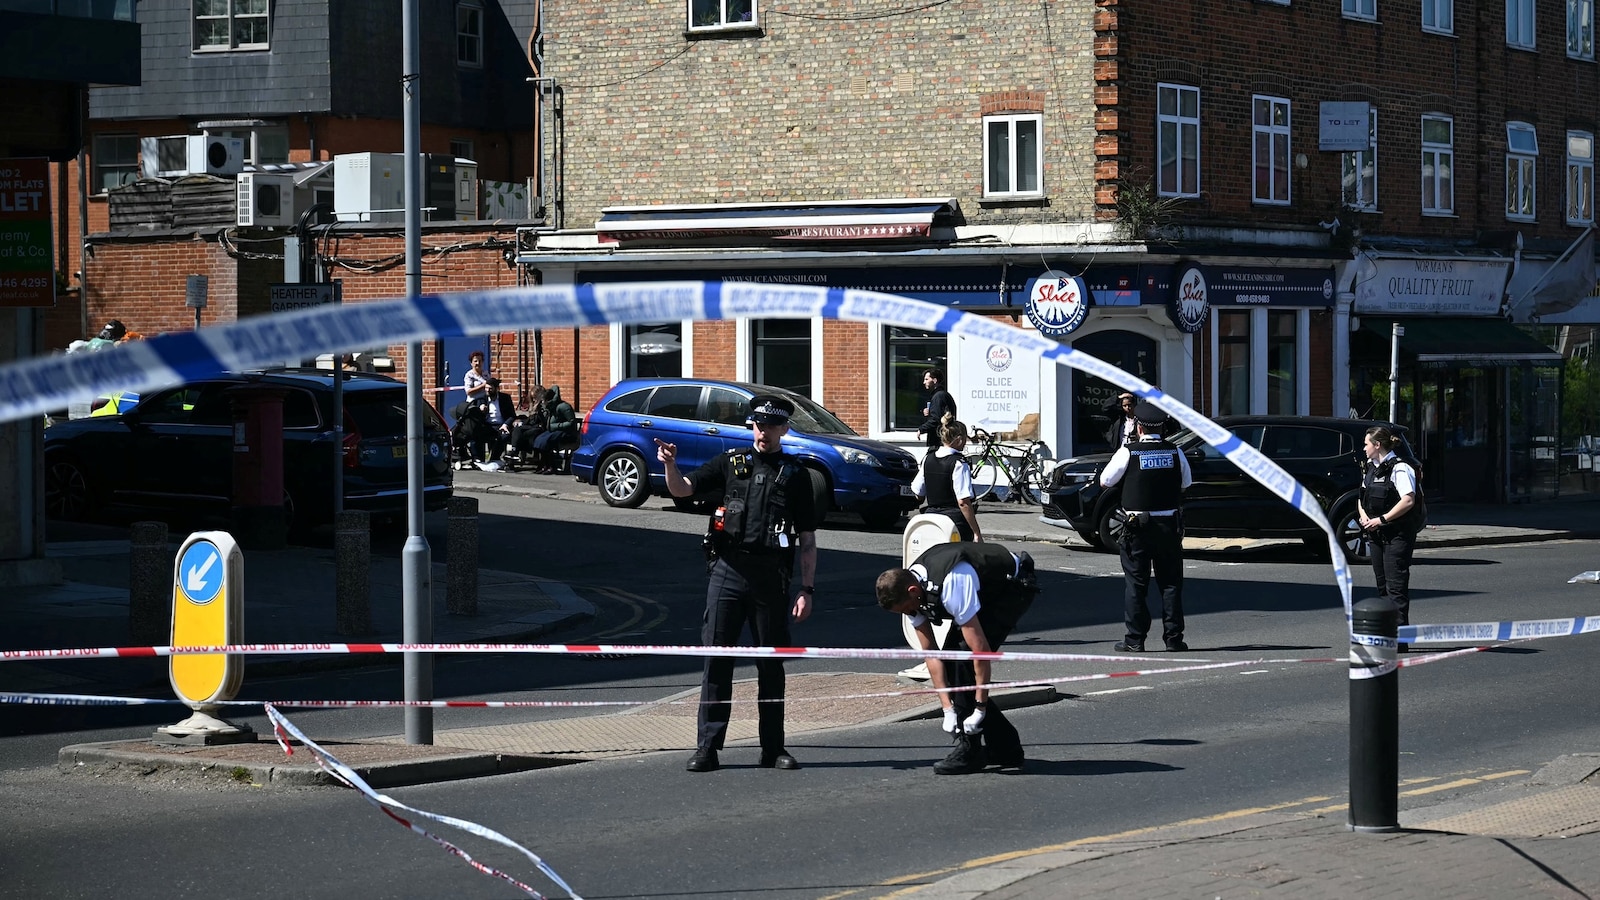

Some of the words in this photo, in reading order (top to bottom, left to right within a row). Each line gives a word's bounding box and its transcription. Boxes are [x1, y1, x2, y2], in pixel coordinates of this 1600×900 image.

[15, 168, 21, 178] 2
[14, 179, 44, 189] FLATS
[0, 191, 43, 212] LET
[801, 226, 861, 238] RESTAURANT
[17, 246, 26, 257] &
[28, 245, 48, 257] Co.
[20, 277, 48, 288] 4295
[1388, 276, 1439, 298] QUALITY
[1441, 278, 1474, 296] FRUIT
[271, 288, 318, 299] HEATHER
[1037, 284, 1076, 304] Slice
[986, 377, 1012, 386] SLICE
[971, 389, 1027, 399] COLLECTION
[986, 402, 1012, 412] ZONE
[1141, 458, 1173, 468] POLICE
